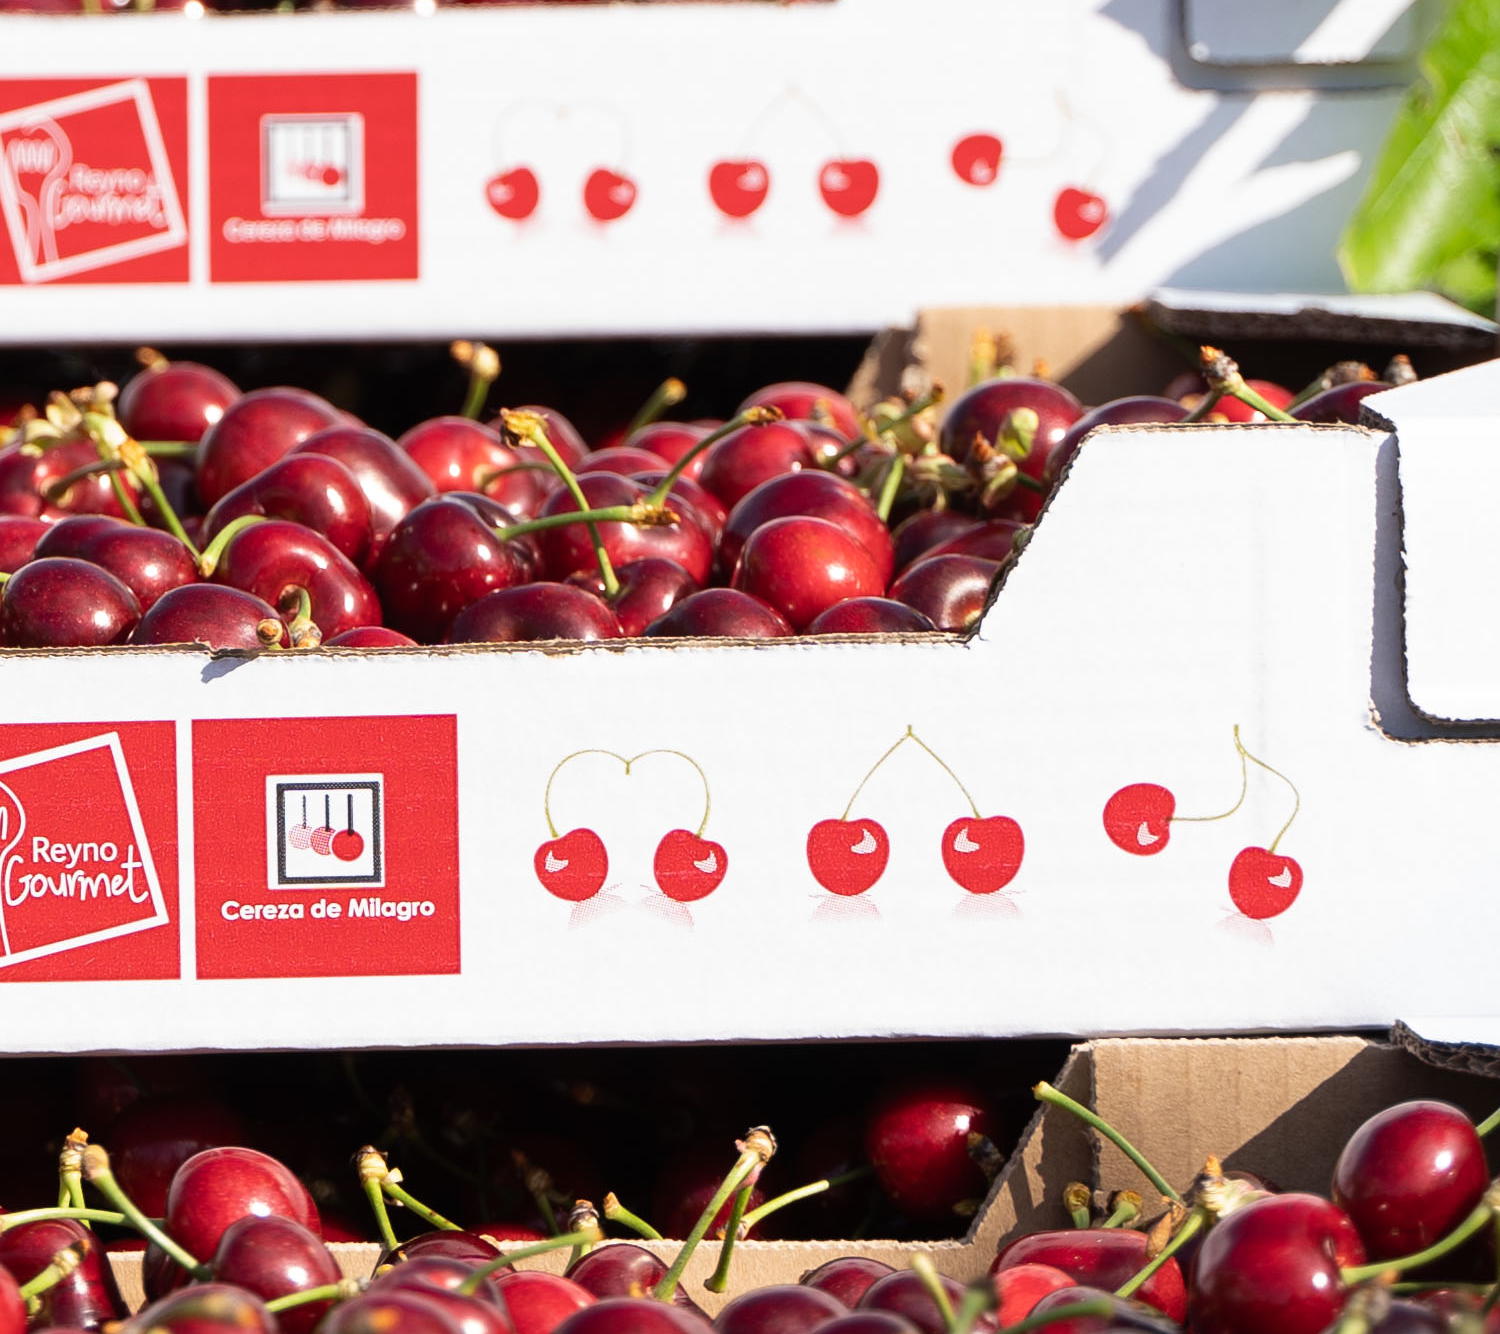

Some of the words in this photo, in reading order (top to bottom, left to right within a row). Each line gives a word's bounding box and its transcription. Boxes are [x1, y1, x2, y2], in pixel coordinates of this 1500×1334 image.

[32, 836, 118, 869] Reyno
[5, 844, 149, 906] Gourmet
[220, 900, 304, 921] Cereza
[310, 898, 342, 920] de
[347, 897, 436, 922] Milagro
